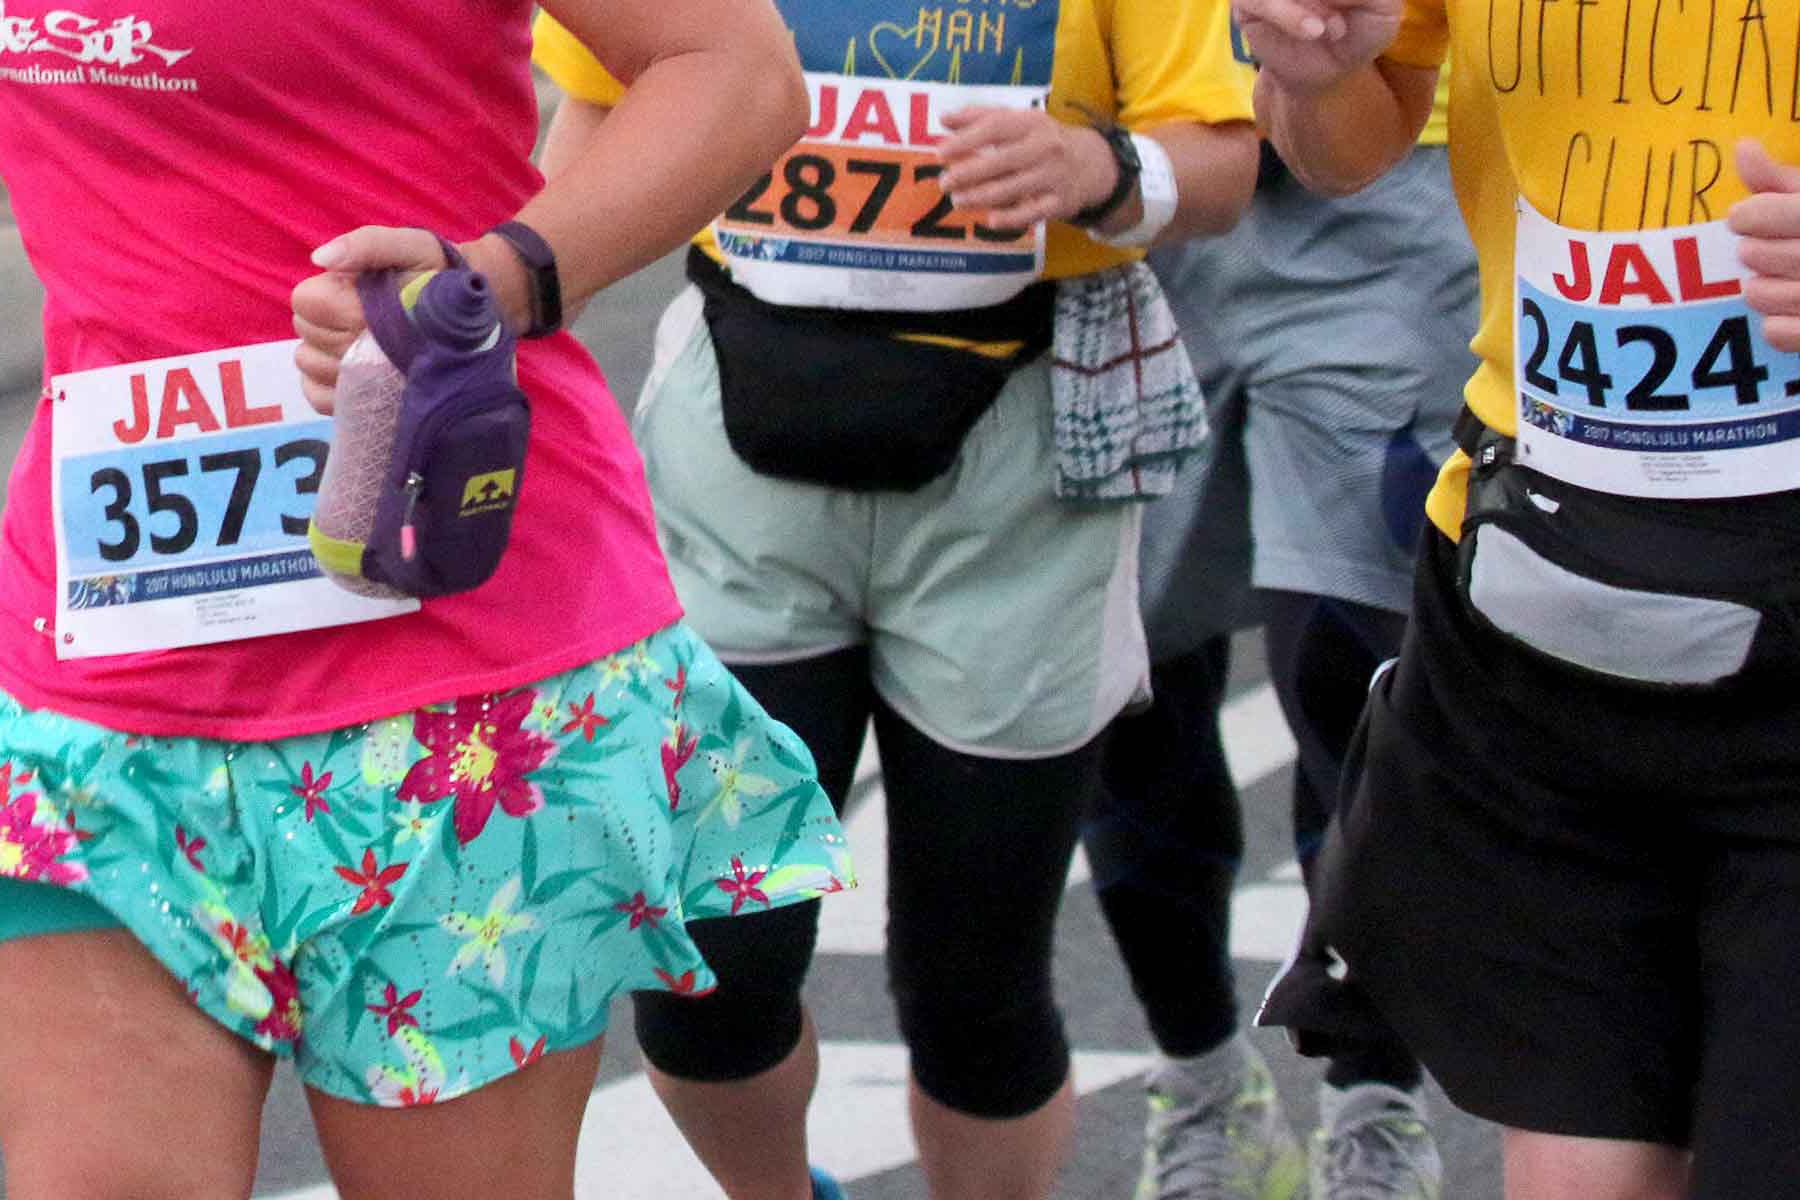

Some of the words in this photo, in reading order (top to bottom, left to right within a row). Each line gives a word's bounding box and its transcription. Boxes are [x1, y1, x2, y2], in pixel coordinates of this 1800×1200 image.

[915, 6, 1006, 54] MAN
[89, 67, 198, 92] Marathon
[807, 84, 945, 146] JAL
[724, 154, 1030, 242] 2872
[1552, 237, 1742, 304] JAL
[1522, 297, 1800, 411] 2424
[112, 359, 284, 445] JAL
[1613, 429, 1689, 446] HONOLULU
[1692, 422, 1778, 445] MARATHON
[144, 574, 170, 594] 2017
[171, 568, 237, 589] HONOLULU
[240, 555, 322, 580] MARATHON
